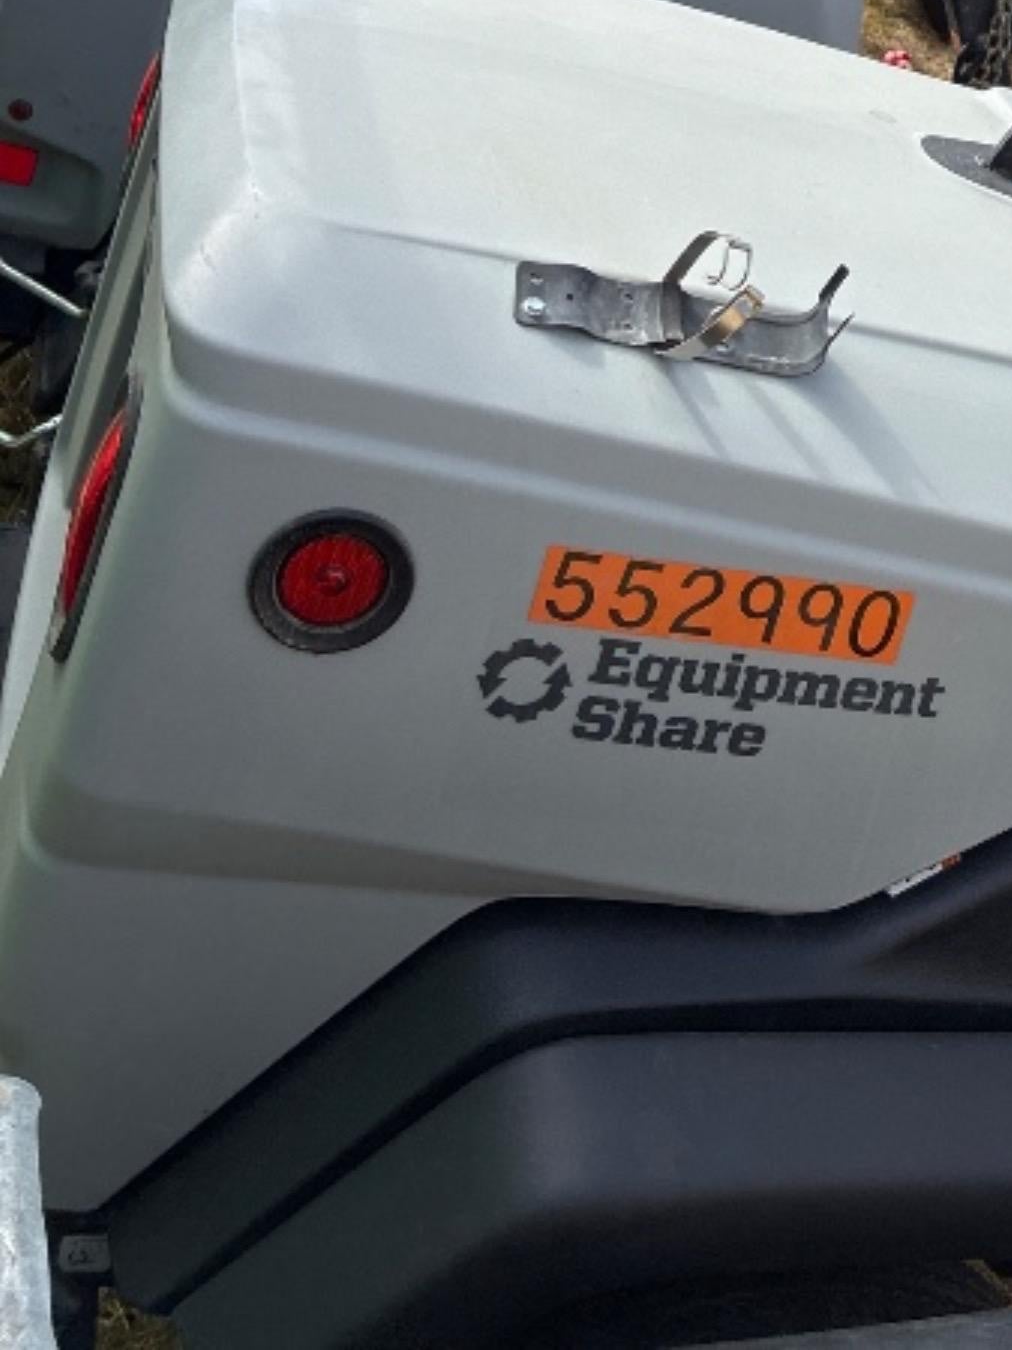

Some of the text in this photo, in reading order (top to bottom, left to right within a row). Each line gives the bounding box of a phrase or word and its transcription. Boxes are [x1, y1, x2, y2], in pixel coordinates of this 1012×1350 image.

[545, 550, 900, 658] 552990
[588, 638, 946, 718] Equipment
[571, 695, 767, 757] Share
